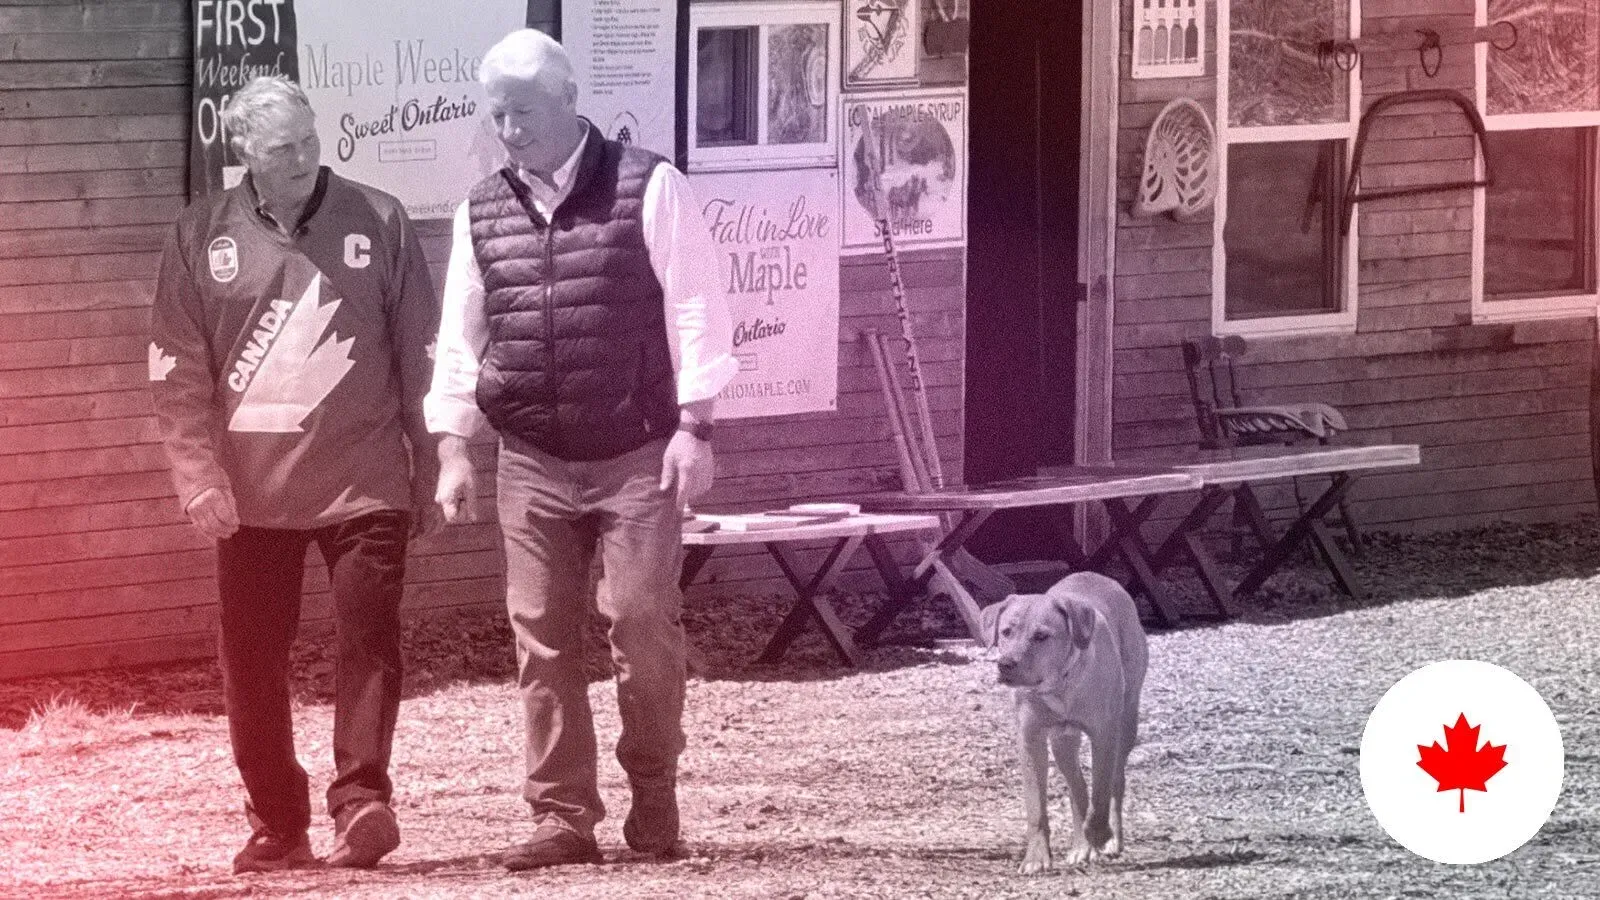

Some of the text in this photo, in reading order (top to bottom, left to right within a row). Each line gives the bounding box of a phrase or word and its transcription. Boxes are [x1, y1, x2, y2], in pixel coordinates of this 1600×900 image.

[197, 0, 285, 49] FIRST
[198, 51, 285, 88] Weekend
[305, 39, 481, 96] Maple Weeke
[198, 94, 229, 145] Of
[338, 94, 476, 162] Sweet Ontario
[848, 104, 885, 128] LOAL
[927, 102, 961, 122] SYRUP
[702, 195, 829, 244] Fall in Love
[874, 217, 933, 237] Sd Here
[344, 234, 371, 268] C
[728, 245, 808, 305] Maple
[228, 299, 293, 393] CANADA
[732, 317, 786, 348] Ontario
